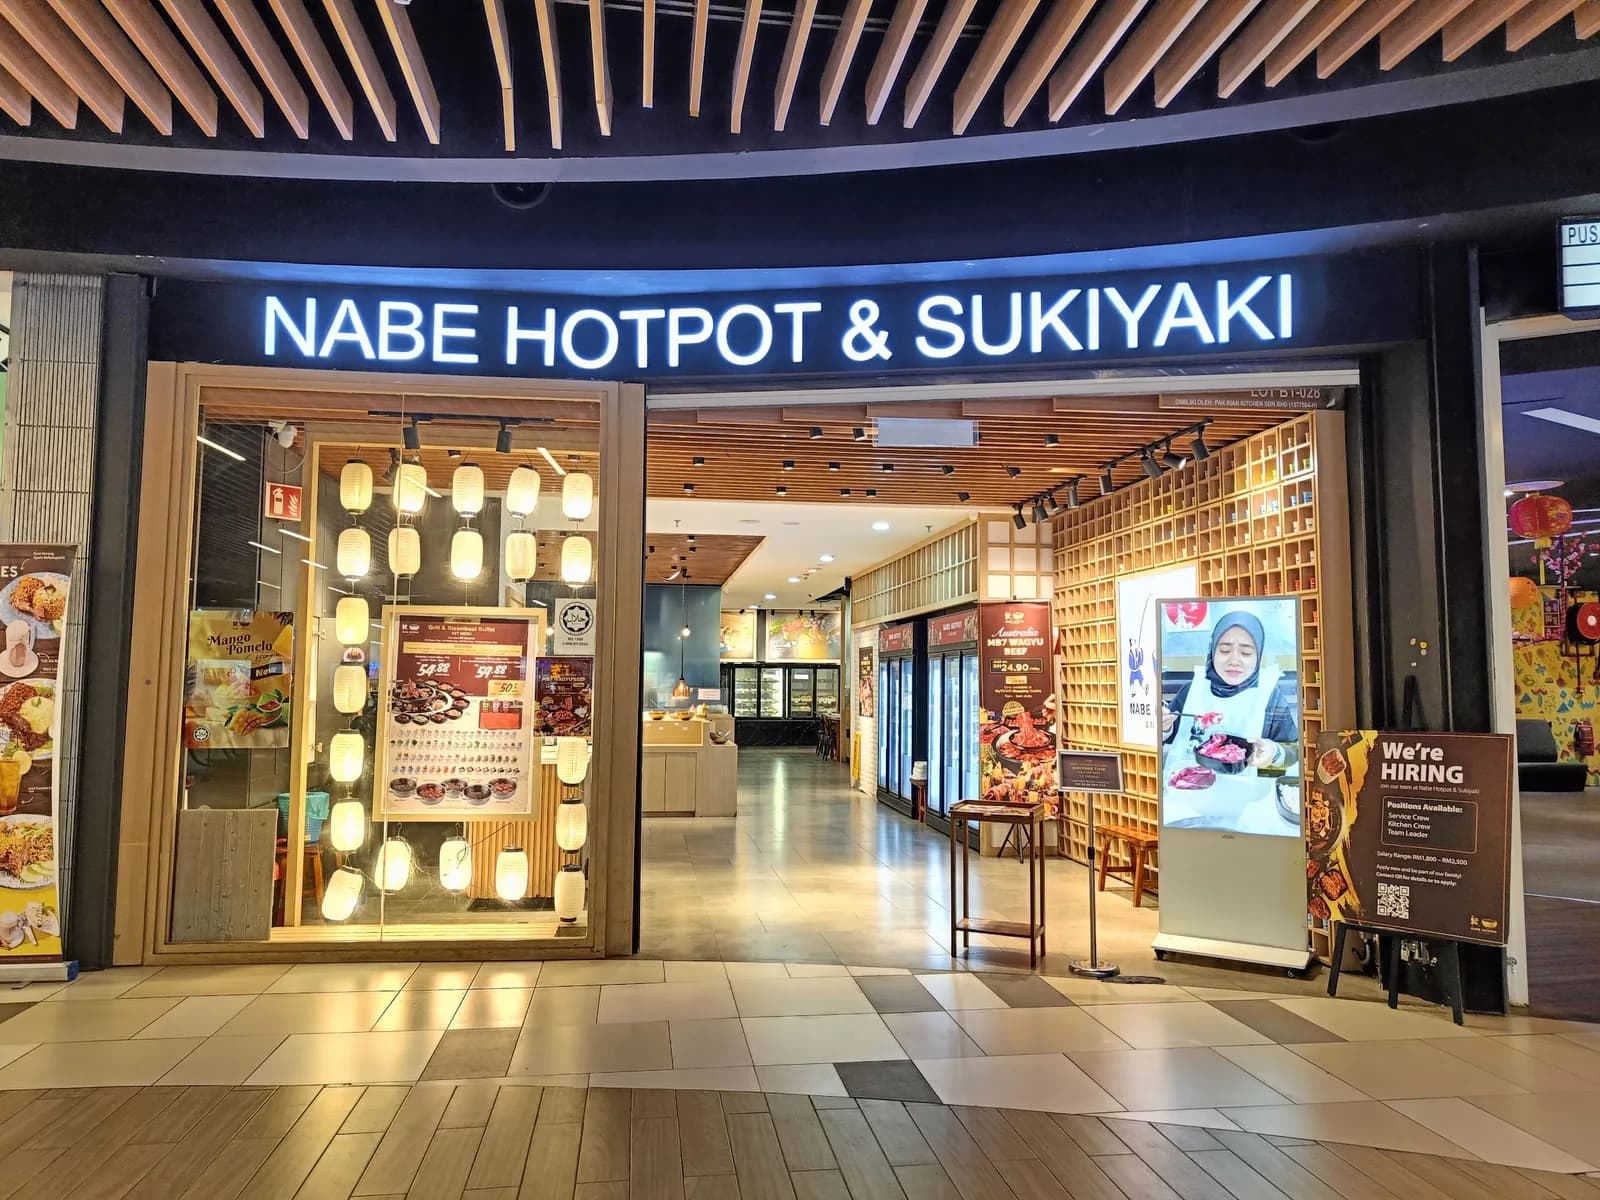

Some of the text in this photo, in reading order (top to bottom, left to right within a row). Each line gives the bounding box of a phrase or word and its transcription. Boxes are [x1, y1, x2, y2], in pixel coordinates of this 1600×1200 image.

[264, 274, 1293, 370] NABE HOTPOT & SUKIYAKI
[992, 626, 1040, 637] Australia
[208, 634, 251, 646] Mango
[987, 638, 1044, 647] MB7 WAGYU
[226, 640, 272, 655] Pomelo
[1130, 703, 1151, 715] NABE
[1382, 742, 1444, 760] We're
[1381, 763, 1464, 784] HIRING
[1387, 801, 1463, 813] Positions Available:
[1388, 812, 1411, 820] Service
[1387, 820, 1431, 830] Kitchen Crew
[1405, 830, 1428, 838] Leader
